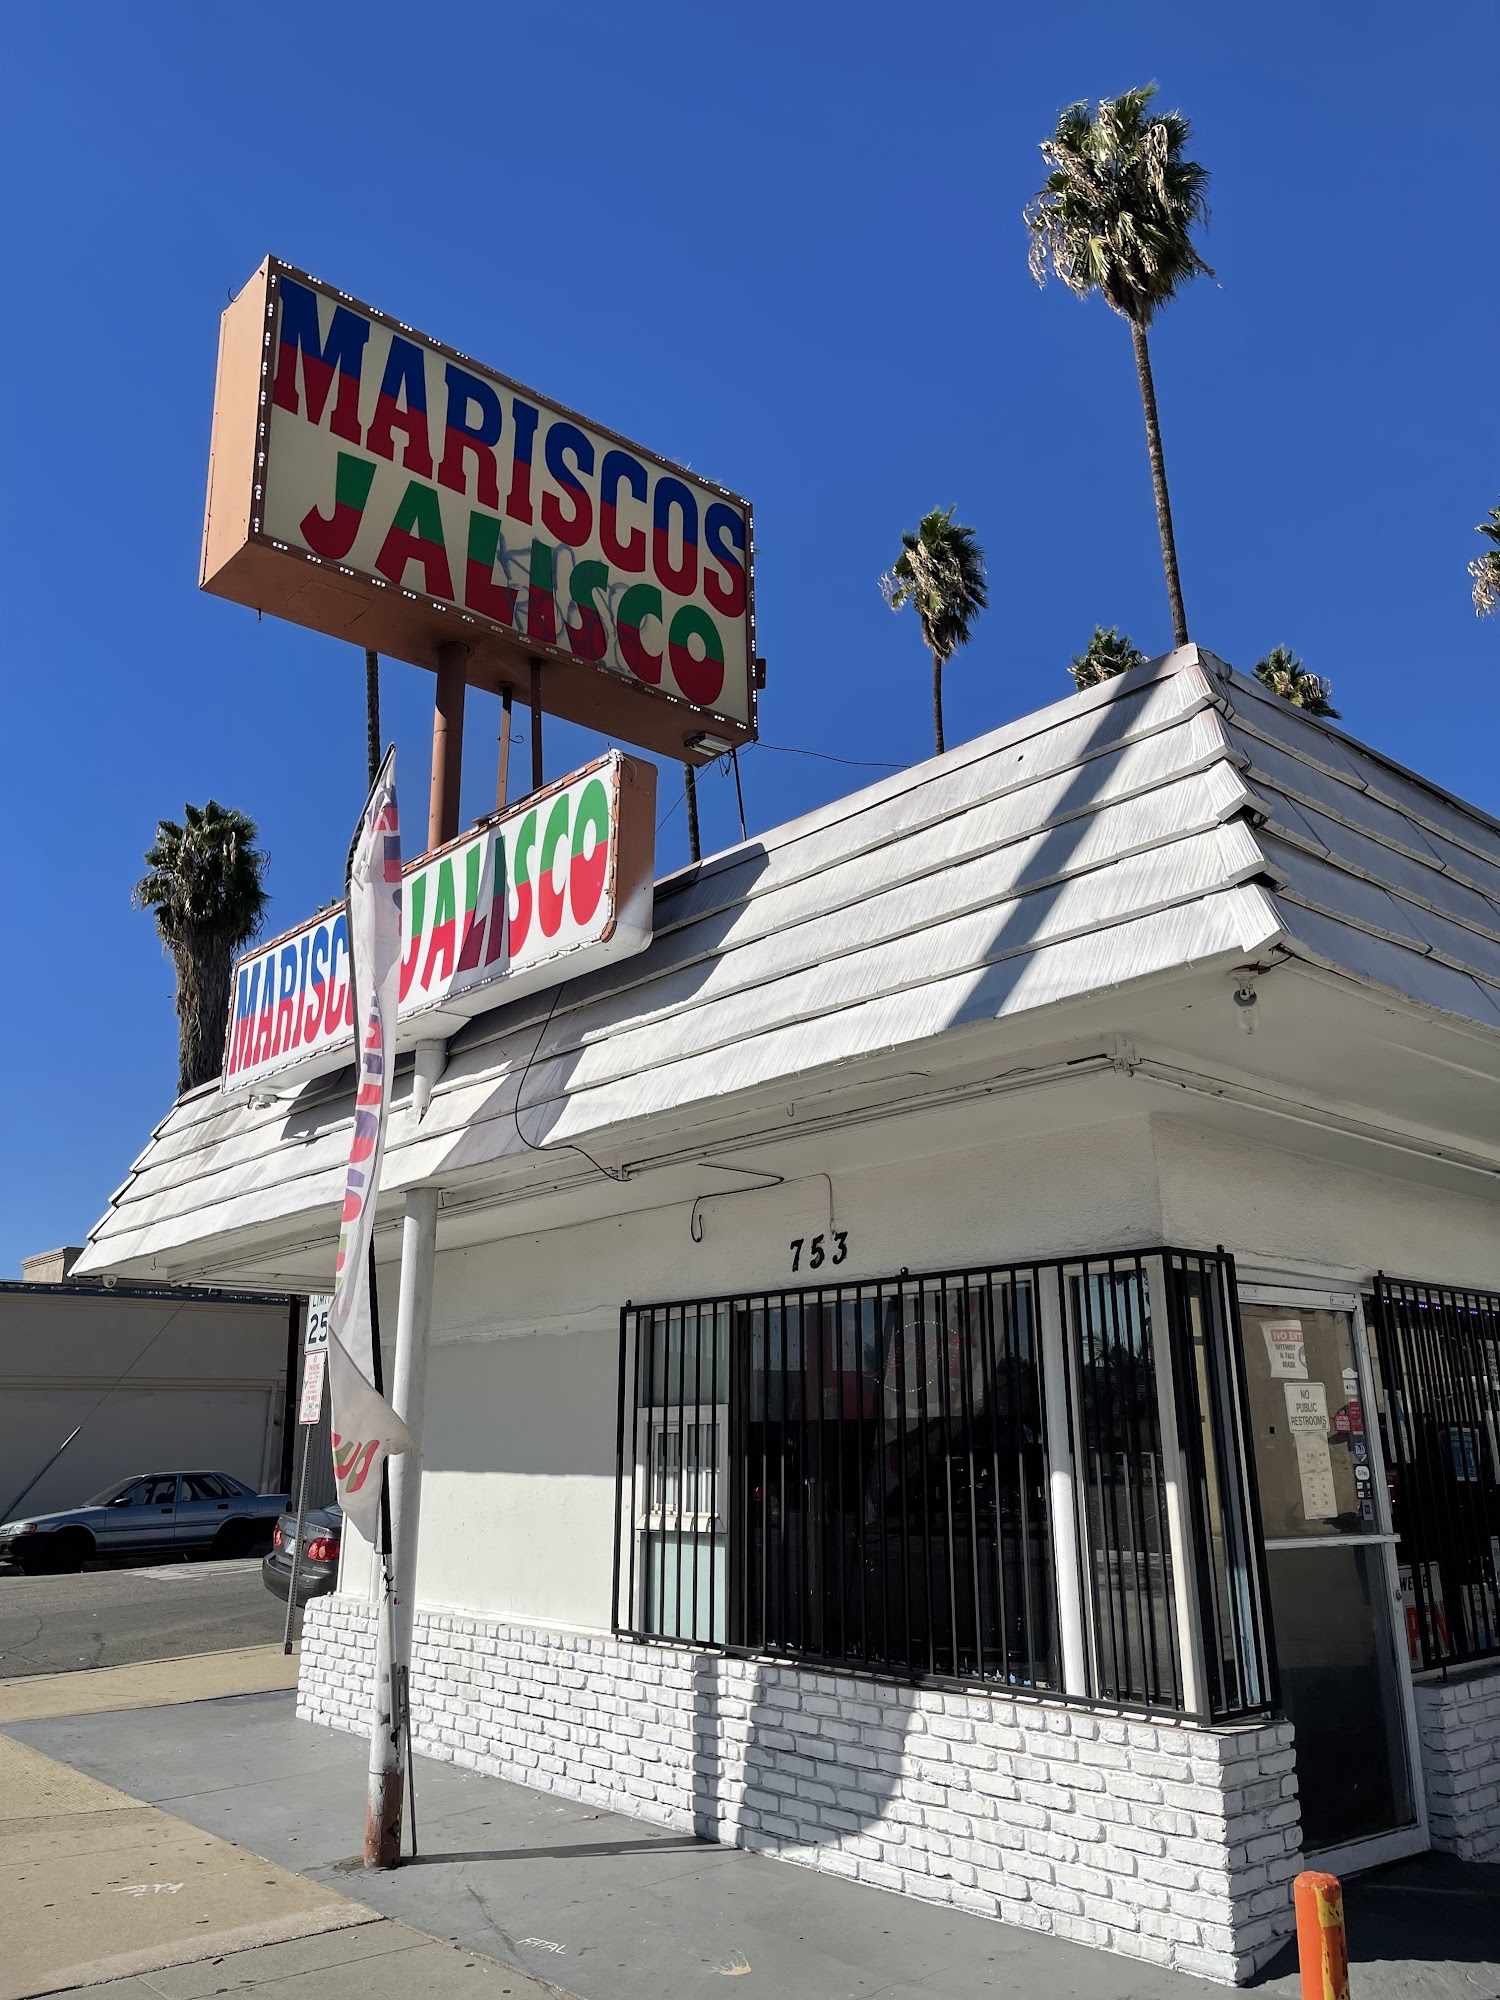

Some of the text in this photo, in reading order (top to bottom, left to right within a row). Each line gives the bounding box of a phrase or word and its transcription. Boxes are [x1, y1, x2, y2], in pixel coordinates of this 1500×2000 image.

[272, 275, 746, 618] MARISCOS
[299, 451, 725, 706] JALISCO
[790, 1231, 848, 1273] 753
[308, 1311, 329, 1344] 25
[1272, 1331, 1288, 1341] NO
[1300, 1389, 1310, 1400] NO
[1295, 1402, 1318, 1413] PUBLIC
[1290, 1415, 1328, 1427] RESTROOMS
